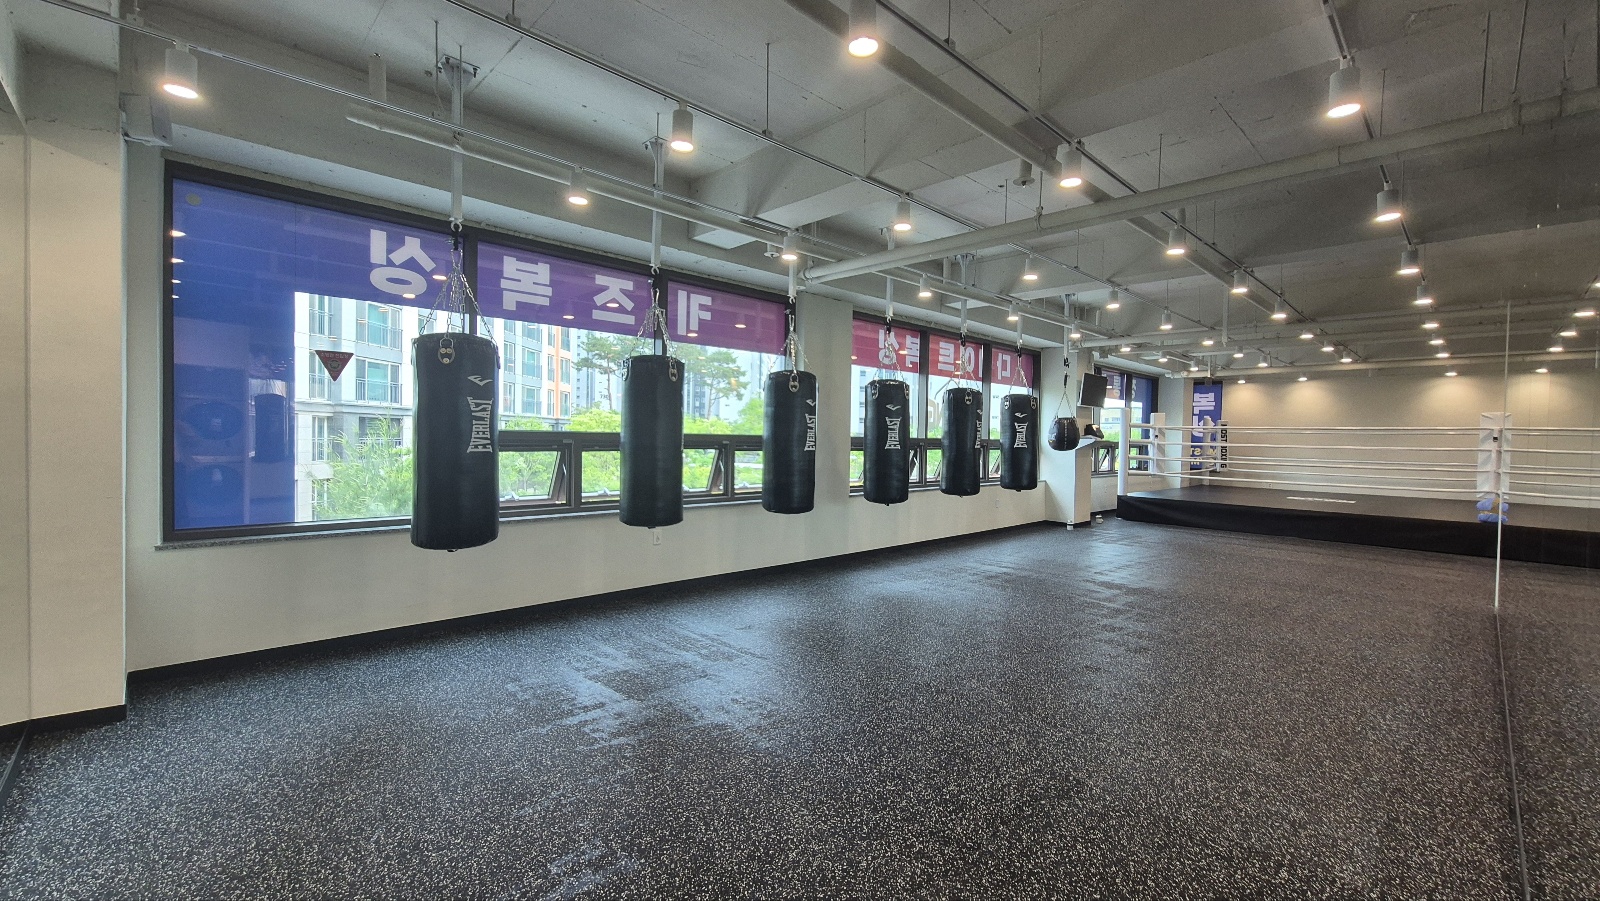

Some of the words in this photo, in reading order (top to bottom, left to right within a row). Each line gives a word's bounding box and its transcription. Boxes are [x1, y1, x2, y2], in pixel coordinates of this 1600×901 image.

[467, 396, 494, 453] EVERLAST
[804, 413, 816, 451] EVERLAST
[885, 416, 902, 450] EVERLAST
[1013, 422, 1029, 449] EVERLAST
